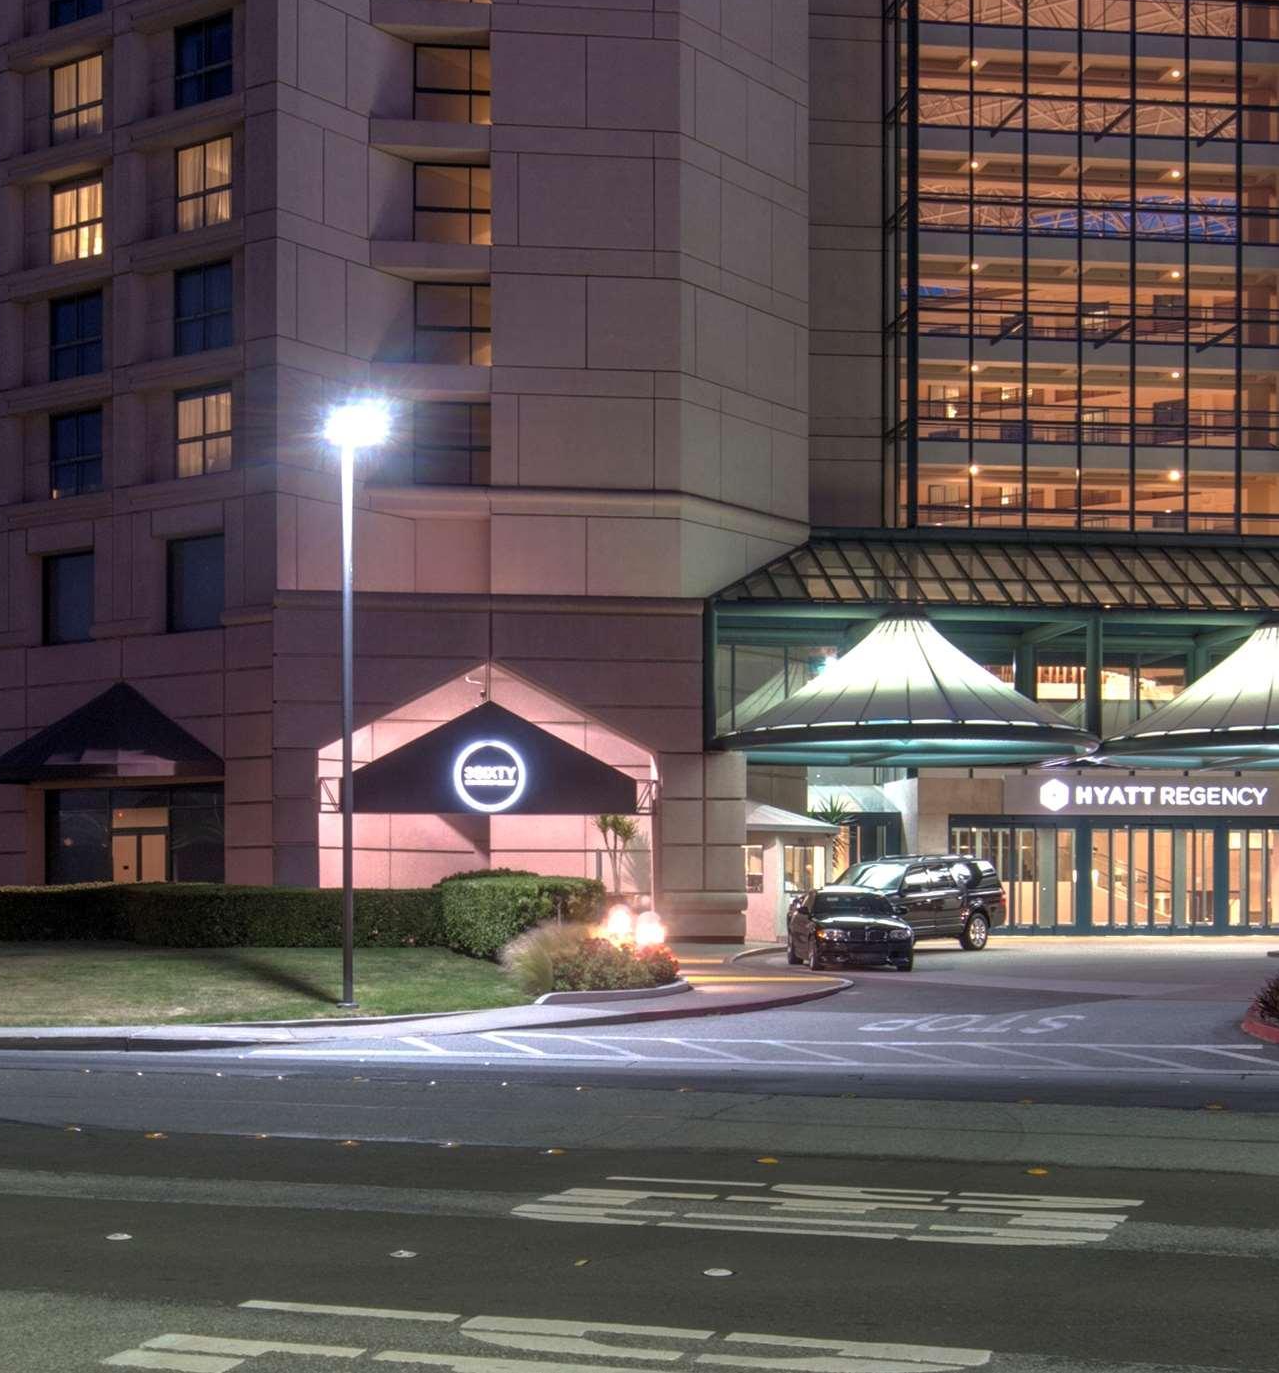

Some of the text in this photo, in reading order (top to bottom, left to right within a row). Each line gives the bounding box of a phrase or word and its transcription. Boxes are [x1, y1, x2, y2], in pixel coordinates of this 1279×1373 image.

[1075, 785, 1269, 806] HYATT REGENCY
[858, 1013, 1086, 1035] STOP
